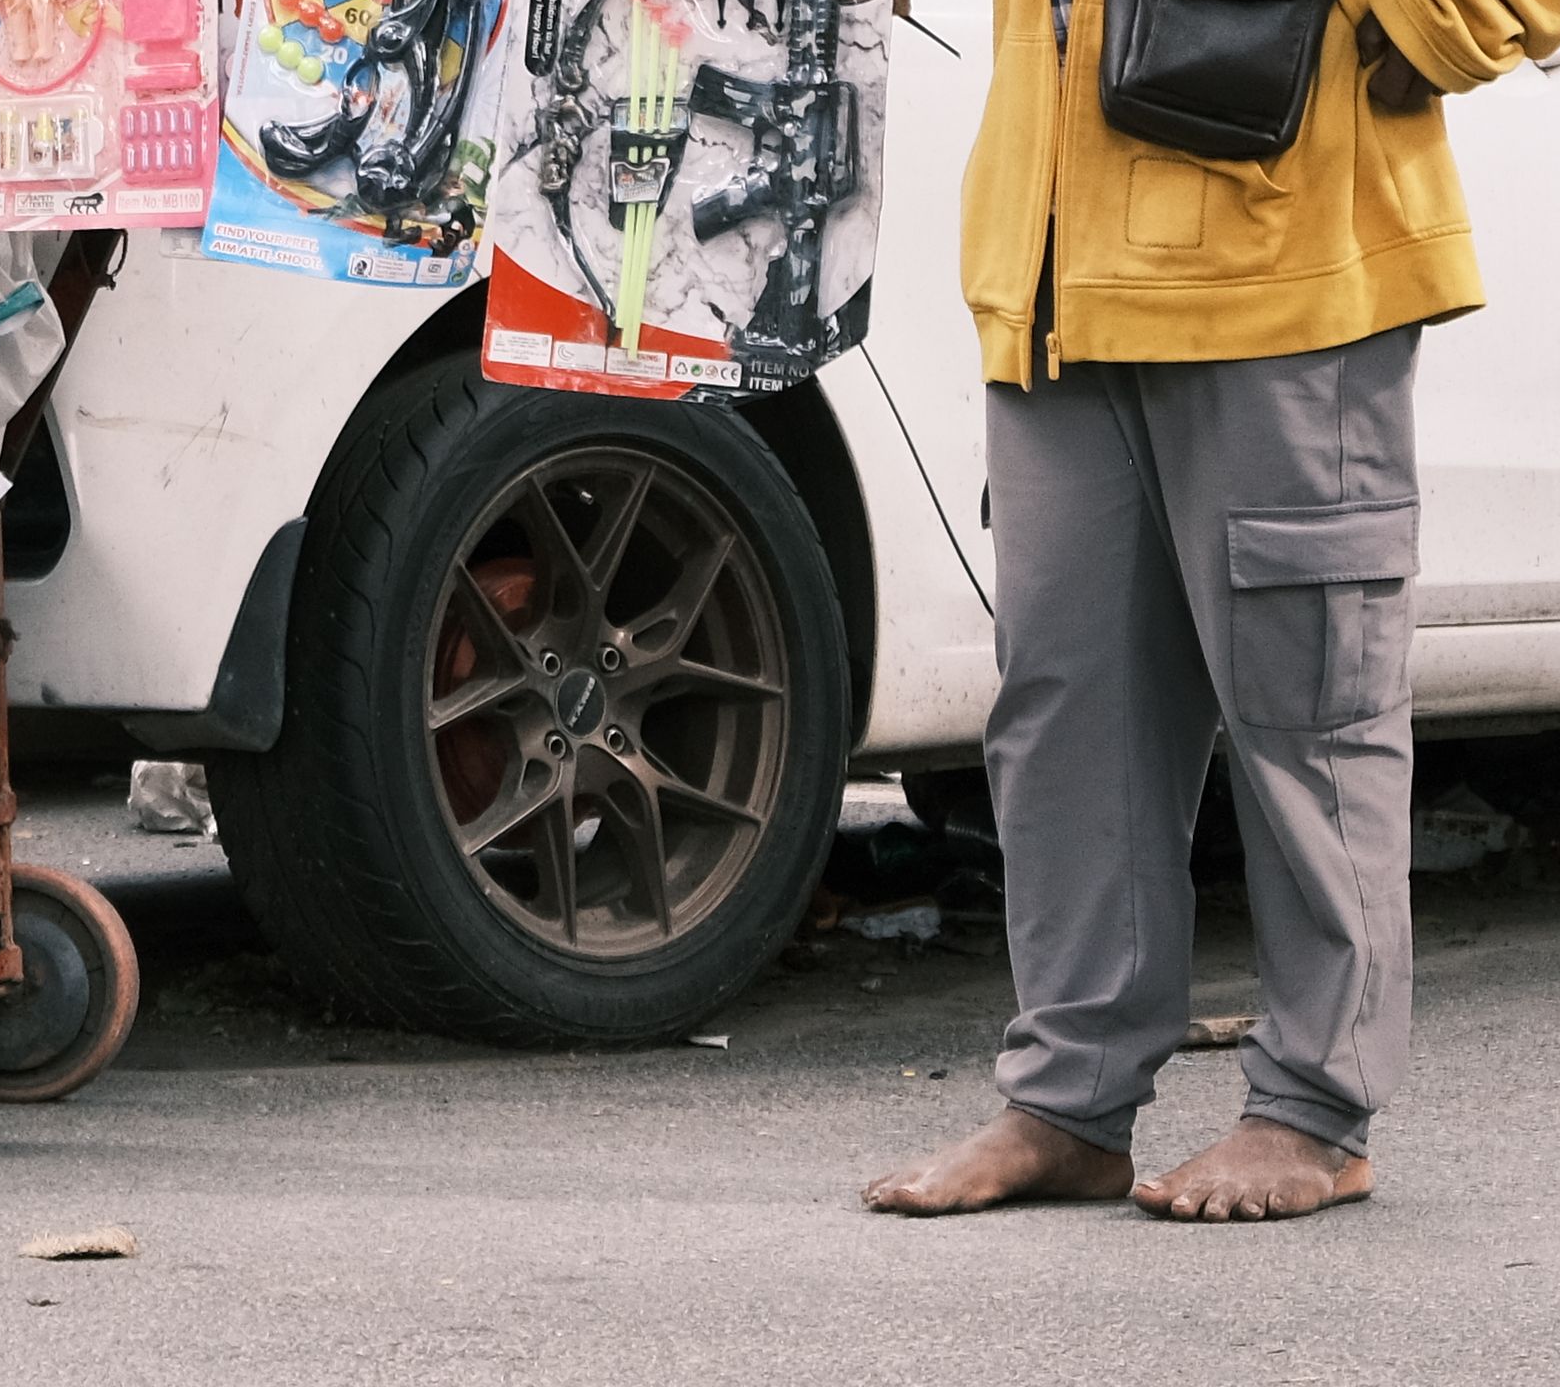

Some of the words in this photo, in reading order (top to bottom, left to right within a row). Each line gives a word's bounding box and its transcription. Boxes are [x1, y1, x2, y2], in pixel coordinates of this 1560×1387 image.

[344, 7, 372, 26] 60
[533, 4, 545, 32] happy
[321, 43, 347, 65] 20
[118, 194, 141, 209] Item
[215, 224, 247, 239] FIND
[247, 229, 279, 243] YOUR
[212, 240, 236, 253] AIM
[752, 360, 785, 375] ITEM
[749, 377, 783, 392] ITEM
